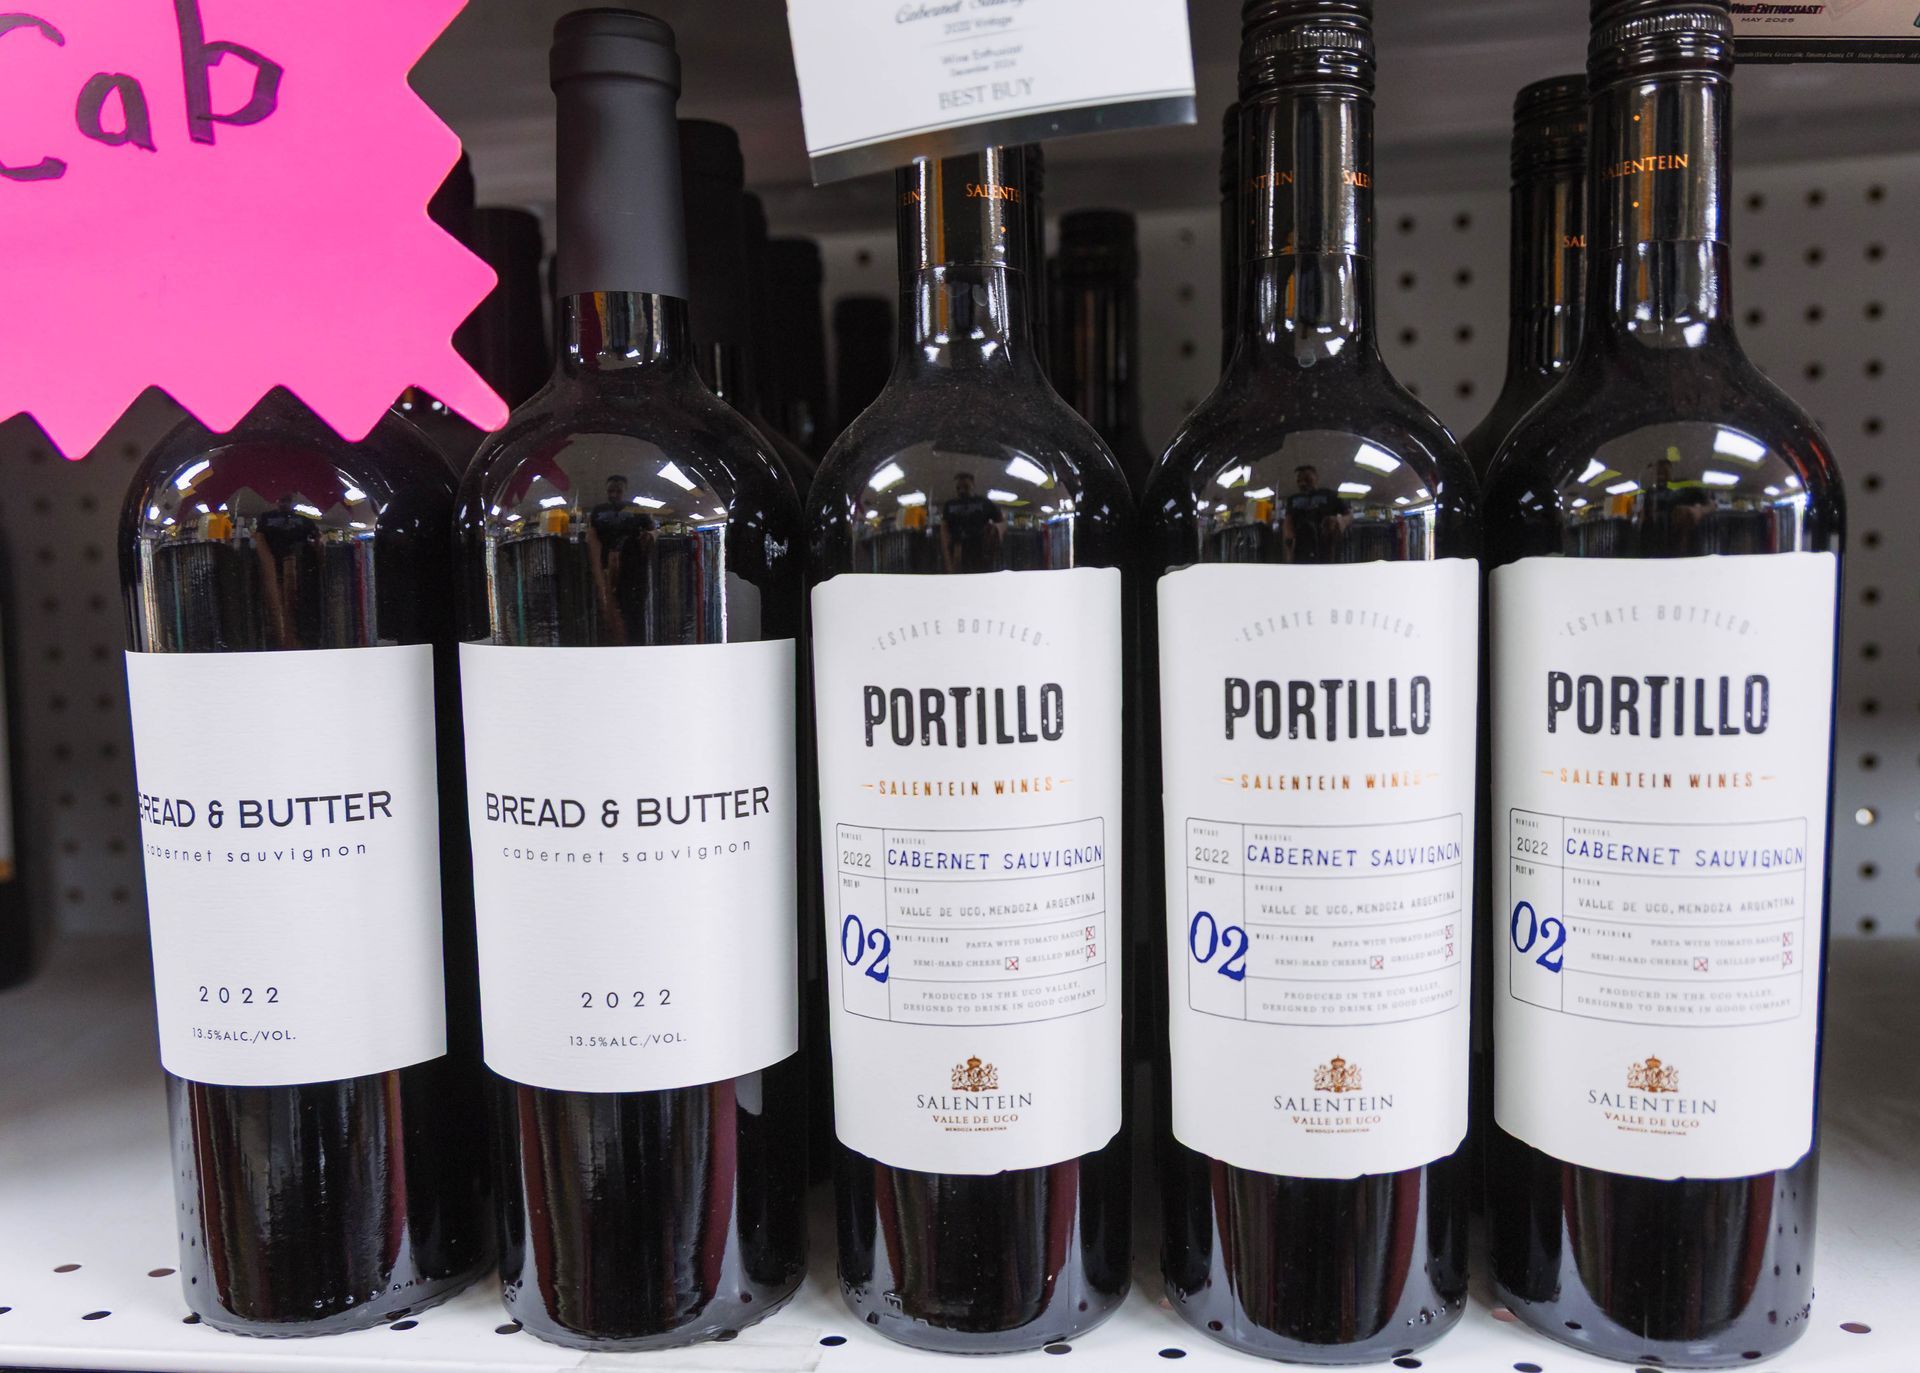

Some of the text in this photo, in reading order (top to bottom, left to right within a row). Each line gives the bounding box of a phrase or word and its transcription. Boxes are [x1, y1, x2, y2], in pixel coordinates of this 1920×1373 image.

[0, 0, 284, 181] Cab
[938, 77, 1035, 110] BEST BUY
[877, 618, 1043, 651] ESTATE BOTTLED
[1224, 675, 1431, 741] PORTILLO
[1548, 671, 1769, 738] PORTILLO
[863, 682, 1064, 748] PORTILLO
[879, 776, 1053, 796] SALENTEIN WINES
[1241, 773, 1422, 790] SALENTEIN WINES
[1560, 768, 1753, 789] SALENTEIN WINES
[208, 800, 224, 828] &
[239, 790, 392, 828] BUTTER
[486, 786, 770, 828] BREAD & BUTTER
[227, 843, 366, 862] sauvignon
[503, 839, 750, 863] cabernet sauvignon
[1194, 847, 1229, 865] 2022
[1247, 842, 1461, 867] CABERNET SAUVIGNON
[1517, 837, 1549, 856] 2022
[1566, 838, 1804, 868] CABERNET SAUVIGNON
[843, 851, 872, 868] 2022
[887, 845, 1102, 871] CABERNET SAUVIGNON
[900, 906, 932, 917] VALLE
[940, 907, 952, 918] DE
[1045, 892, 1096, 910] ARGENTINA
[1261, 904, 1297, 915] VALLE
[1305, 905, 1319, 915] DE
[1578, 897, 1614, 910] VALLE
[1623, 900, 1637, 912] DE
[996, 939, 1020, 948] WITH
[1189, 911, 1249, 982] 02
[1511, 901, 1566, 973] 02
[842, 914, 891, 984] 02
[199, 986, 279, 1003] 2022
[581, 989, 671, 1008] 2022
[922, 991, 977, 1001] PRODUCED
[981, 991, 993, 1000] IN
[996, 990, 1018, 999] THE
[1347, 991, 1359, 1000] IN
[1362, 990, 1382, 999] THE
[1665, 990, 1678, 999] IN
[1683, 991, 1706, 1000] THE
[903, 1003, 954, 1013] DESIGNED
[957, 1004, 971, 1013] TO
[974, 1003, 1008, 1012] DRINK
[1321, 1004, 1335, 1013] TO
[1339, 1003, 1373, 1012] DRINK
[1638, 1003, 1654, 1012] TO
[1657, 1003, 1694, 1013] DRINK
[916, 1093, 1032, 1110] SALENTEIN
[1274, 1094, 1393, 1112] SALENTEIN
[1588, 1089, 1716, 1114] SALENTEIN
[932, 1114, 1019, 1124] VALLE DE UCO
[1292, 1115, 1381, 1125] VALLE DE UCO
[1604, 1111, 1699, 1128] VALLE DE UCO
